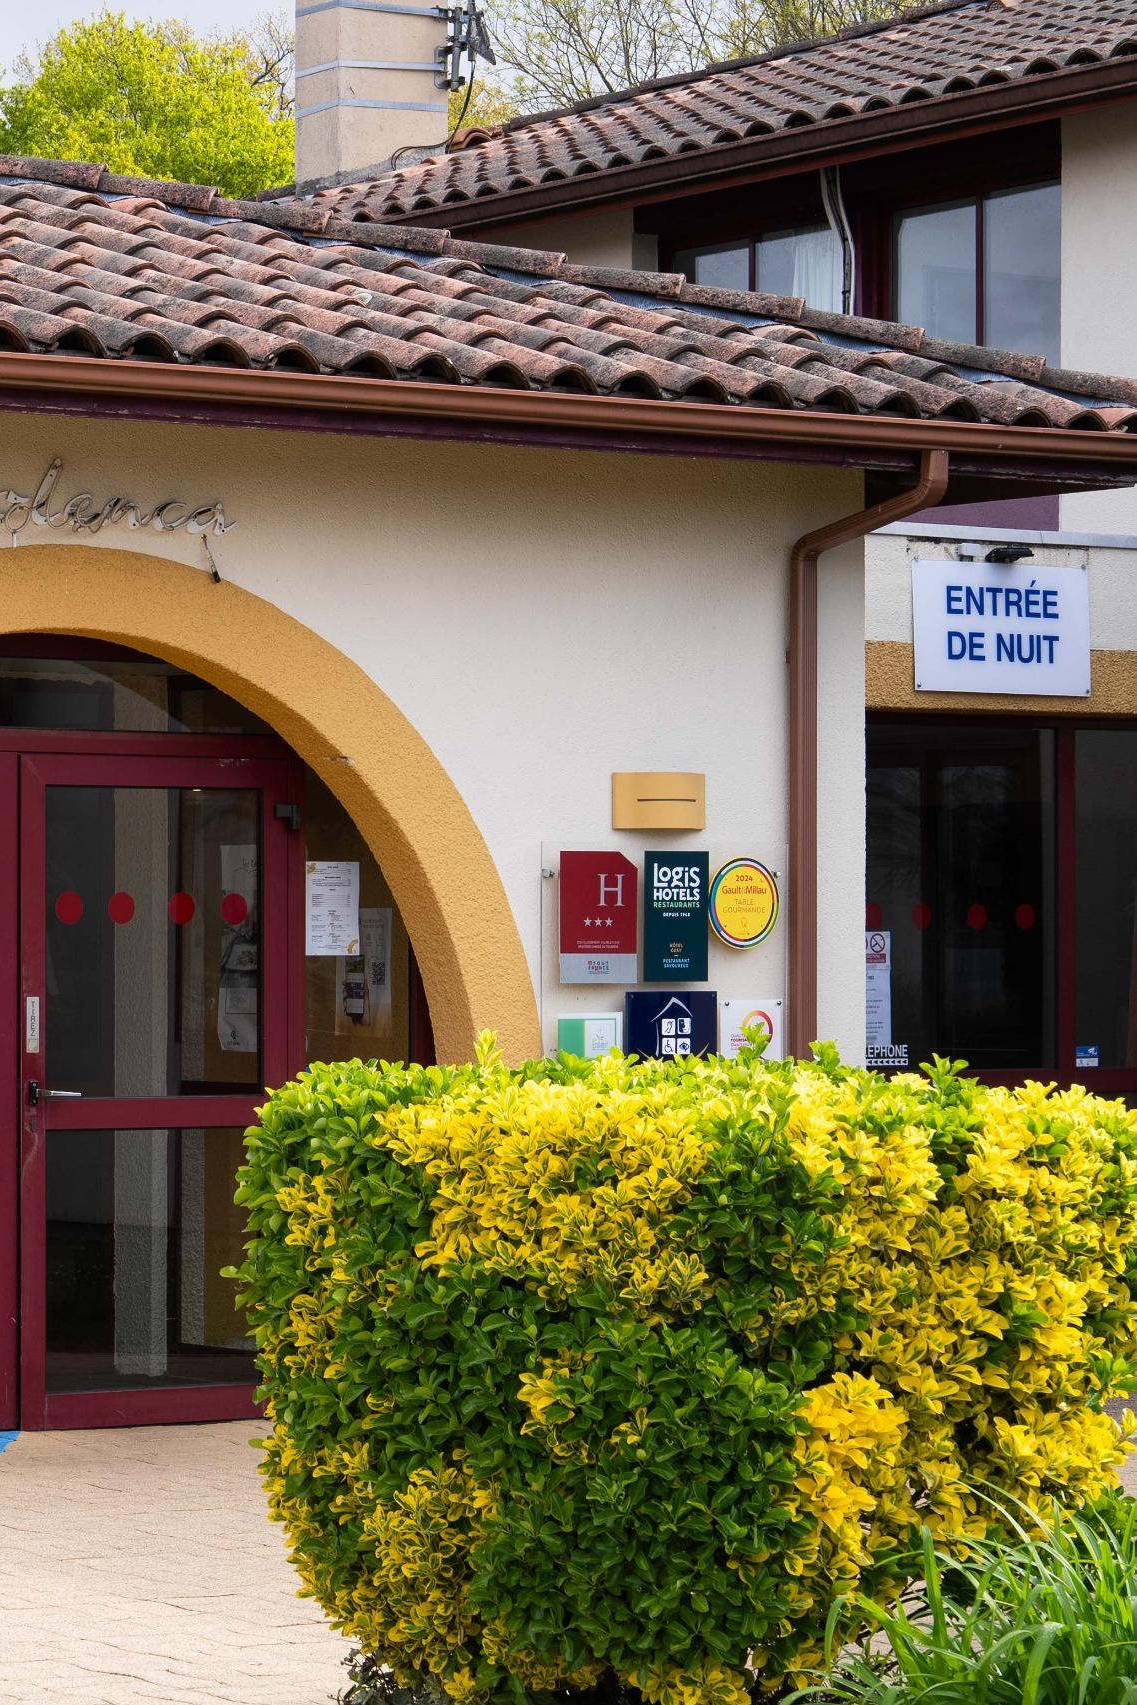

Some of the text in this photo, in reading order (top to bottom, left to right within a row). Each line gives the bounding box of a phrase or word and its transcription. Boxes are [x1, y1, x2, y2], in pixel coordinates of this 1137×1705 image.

[945, 579, 1060, 619] ENTRÉE
[947, 631, 1060, 664] DE NUIT
[735, 874, 753, 882] 2024
[596, 873, 626, 907] H
[653, 888, 701, 901] HOTELS
[653, 901, 701, 909] RESTAURANTS
[734, 898, 755, 906] TABLE
[722, 906, 767, 914] GOURMANDE
